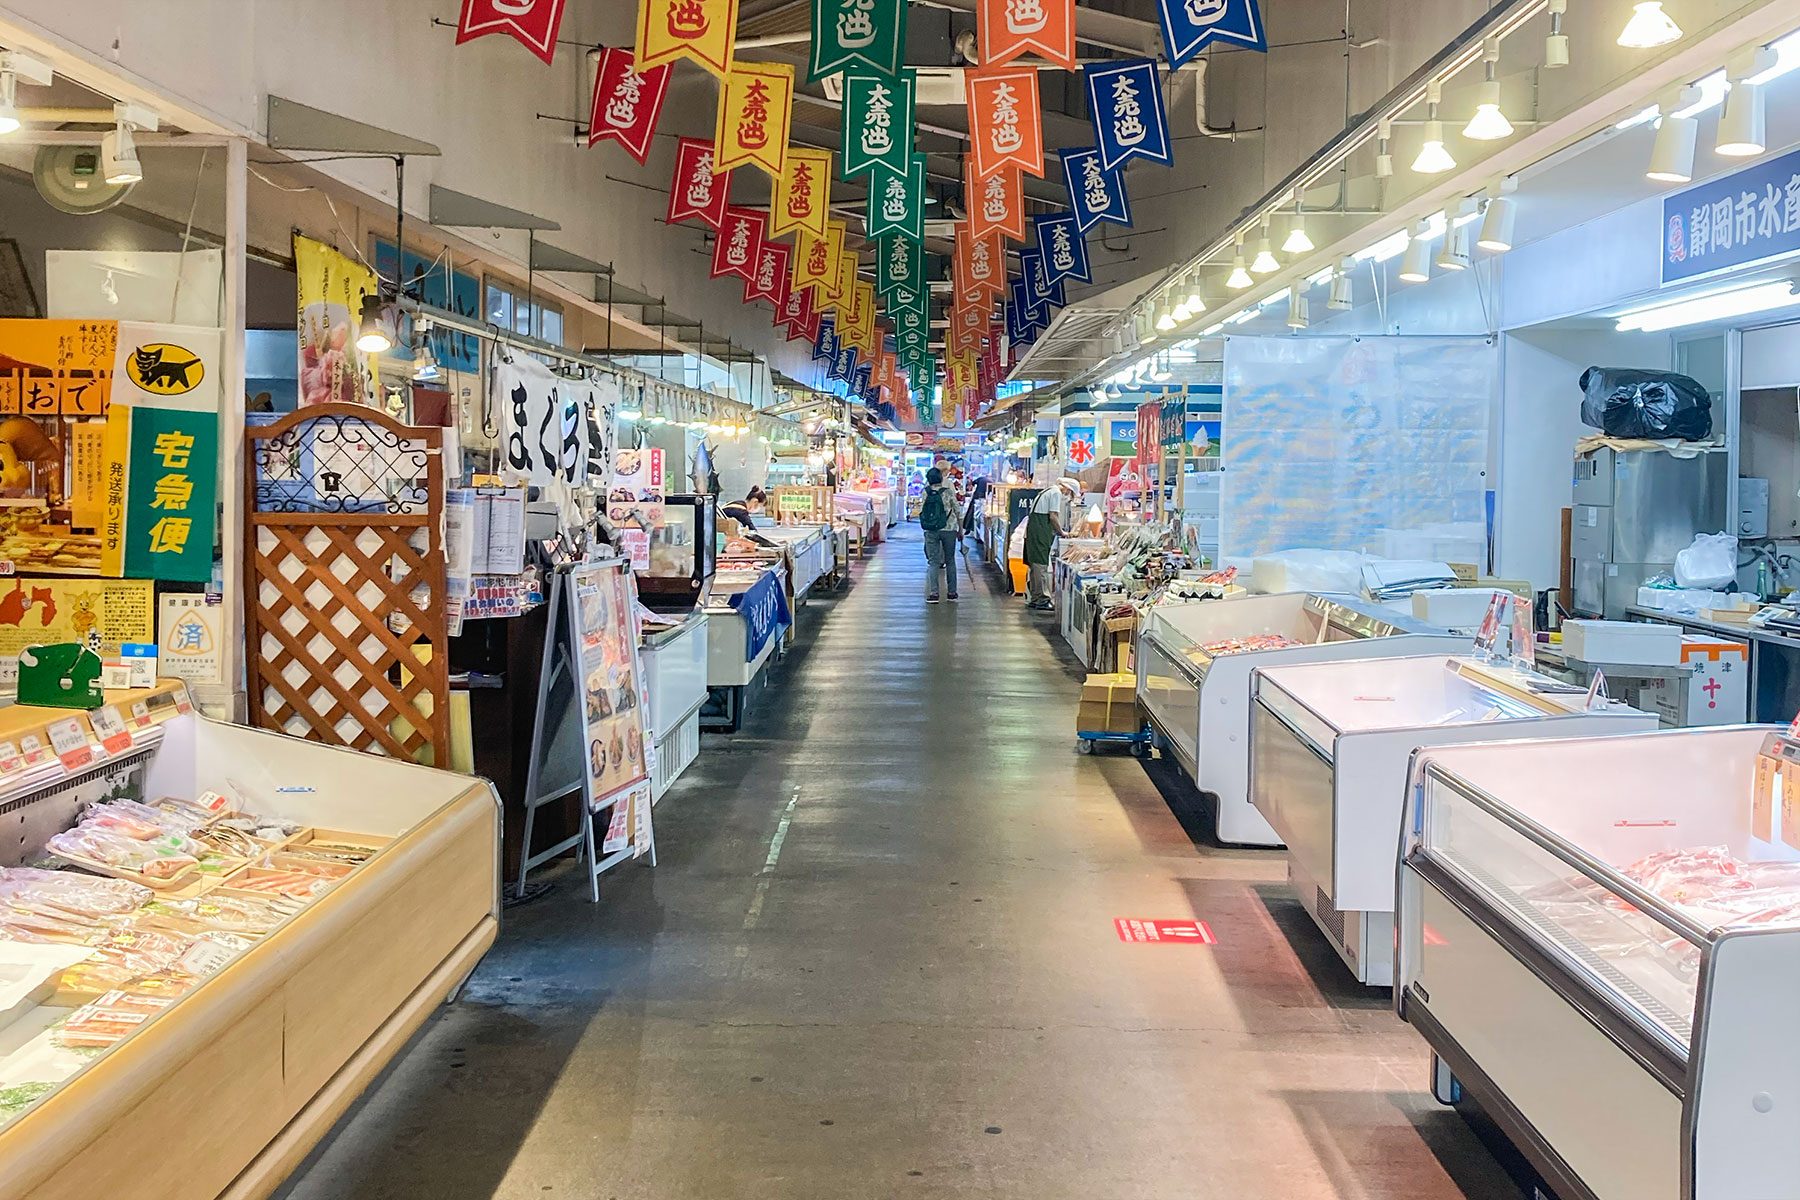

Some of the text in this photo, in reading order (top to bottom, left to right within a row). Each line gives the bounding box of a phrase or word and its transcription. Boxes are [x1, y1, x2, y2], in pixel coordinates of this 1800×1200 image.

[736, 79, 771, 150] 大売出
[861, 83, 893, 155] 大売出
[991, 82, 1023, 153] 大売出
[1112, 75, 1146, 146] 大売出
[687, 152, 714, 208] 大売出
[787, 161, 814, 219] 大売出
[882, 176, 908, 221] 売出
[1082, 155, 1111, 213] 大売出
[727, 220, 751, 265] 大売出
[807, 238, 829, 276] 売出
[889, 234, 910, 281] 大売出
[1053, 224, 1075, 271] 大売出
[757, 252, 777, 291] 大売出
[27, 379, 110, 412] おで
[1070, 440, 1094, 464] 氷
[107, 462, 124, 551] 発送承ります
[149, 431, 194, 555] 宅急便
[177, 623, 204, 649] 済
